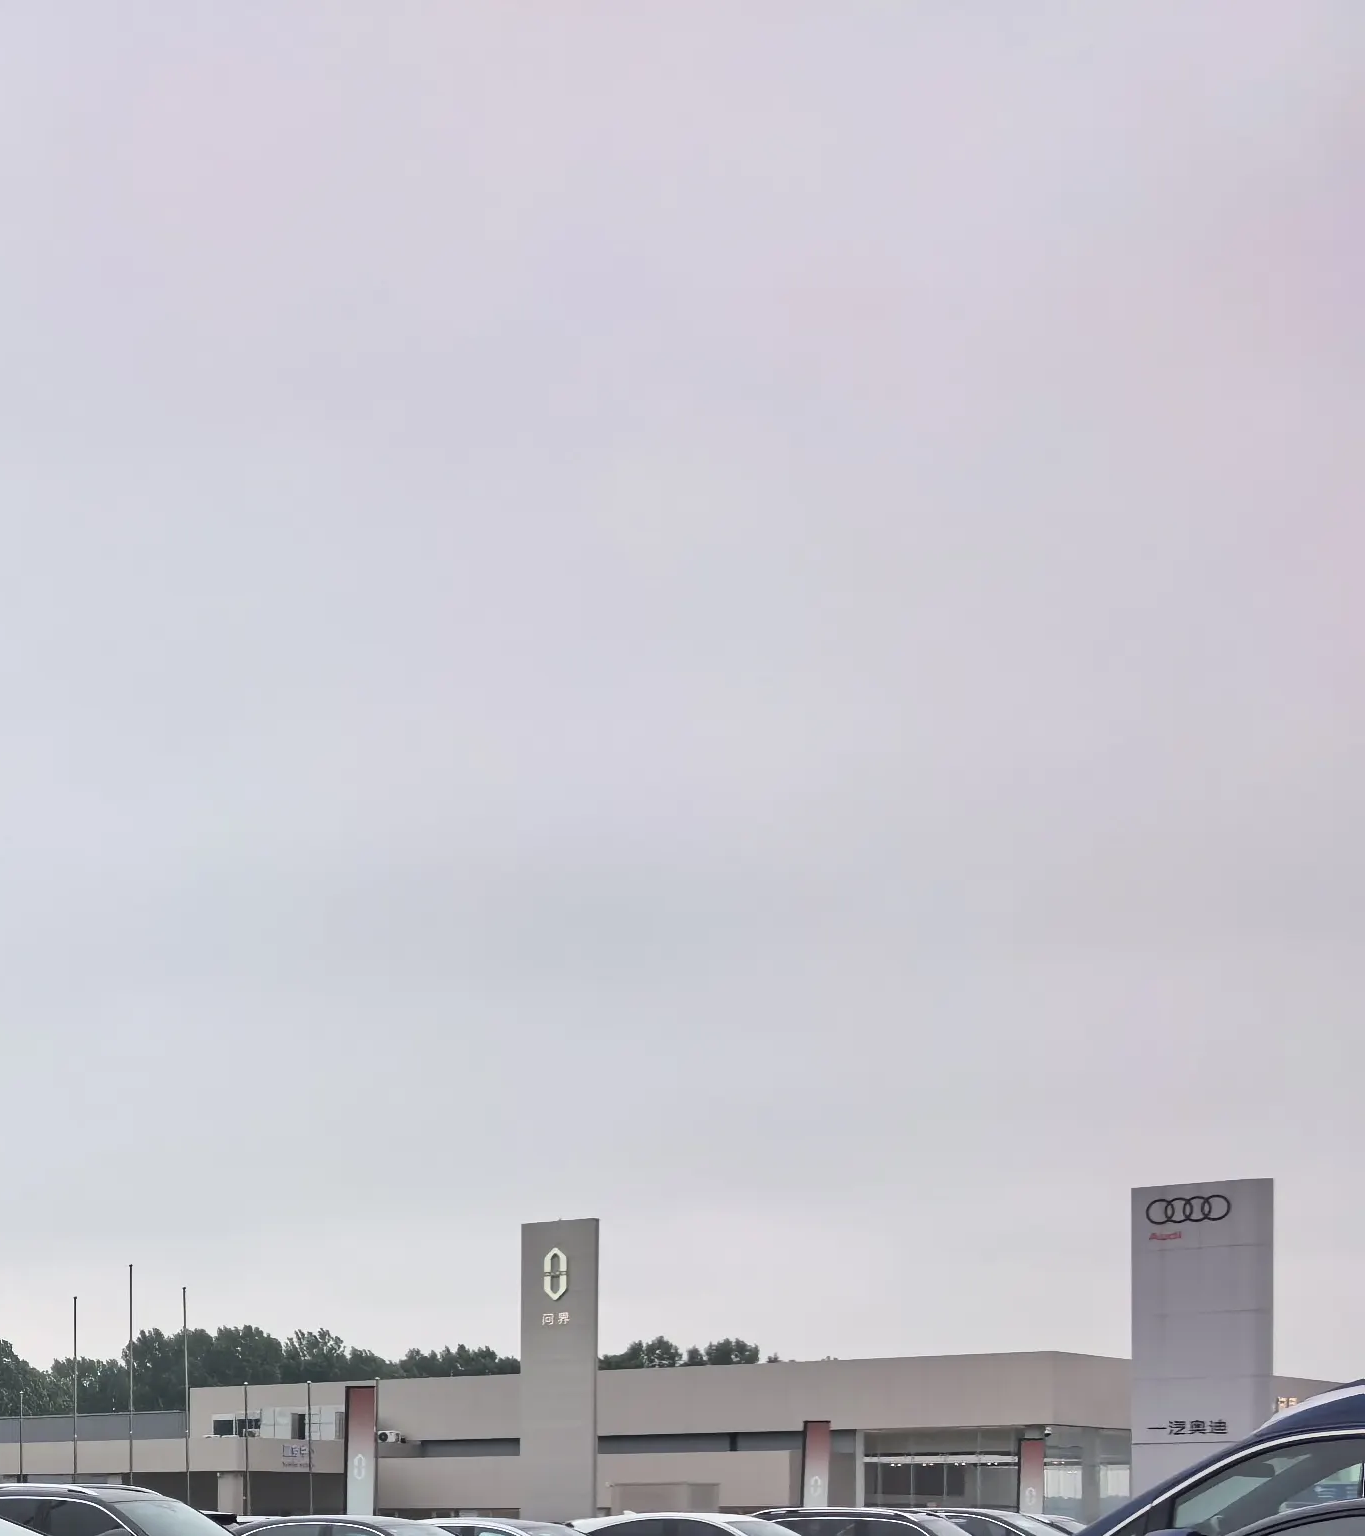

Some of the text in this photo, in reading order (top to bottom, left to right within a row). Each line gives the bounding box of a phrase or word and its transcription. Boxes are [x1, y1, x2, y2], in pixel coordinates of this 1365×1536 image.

[1148, 1230, 1183, 1241] Audi
[1146, 1419, 1229, 1436] 一汽奥迪
